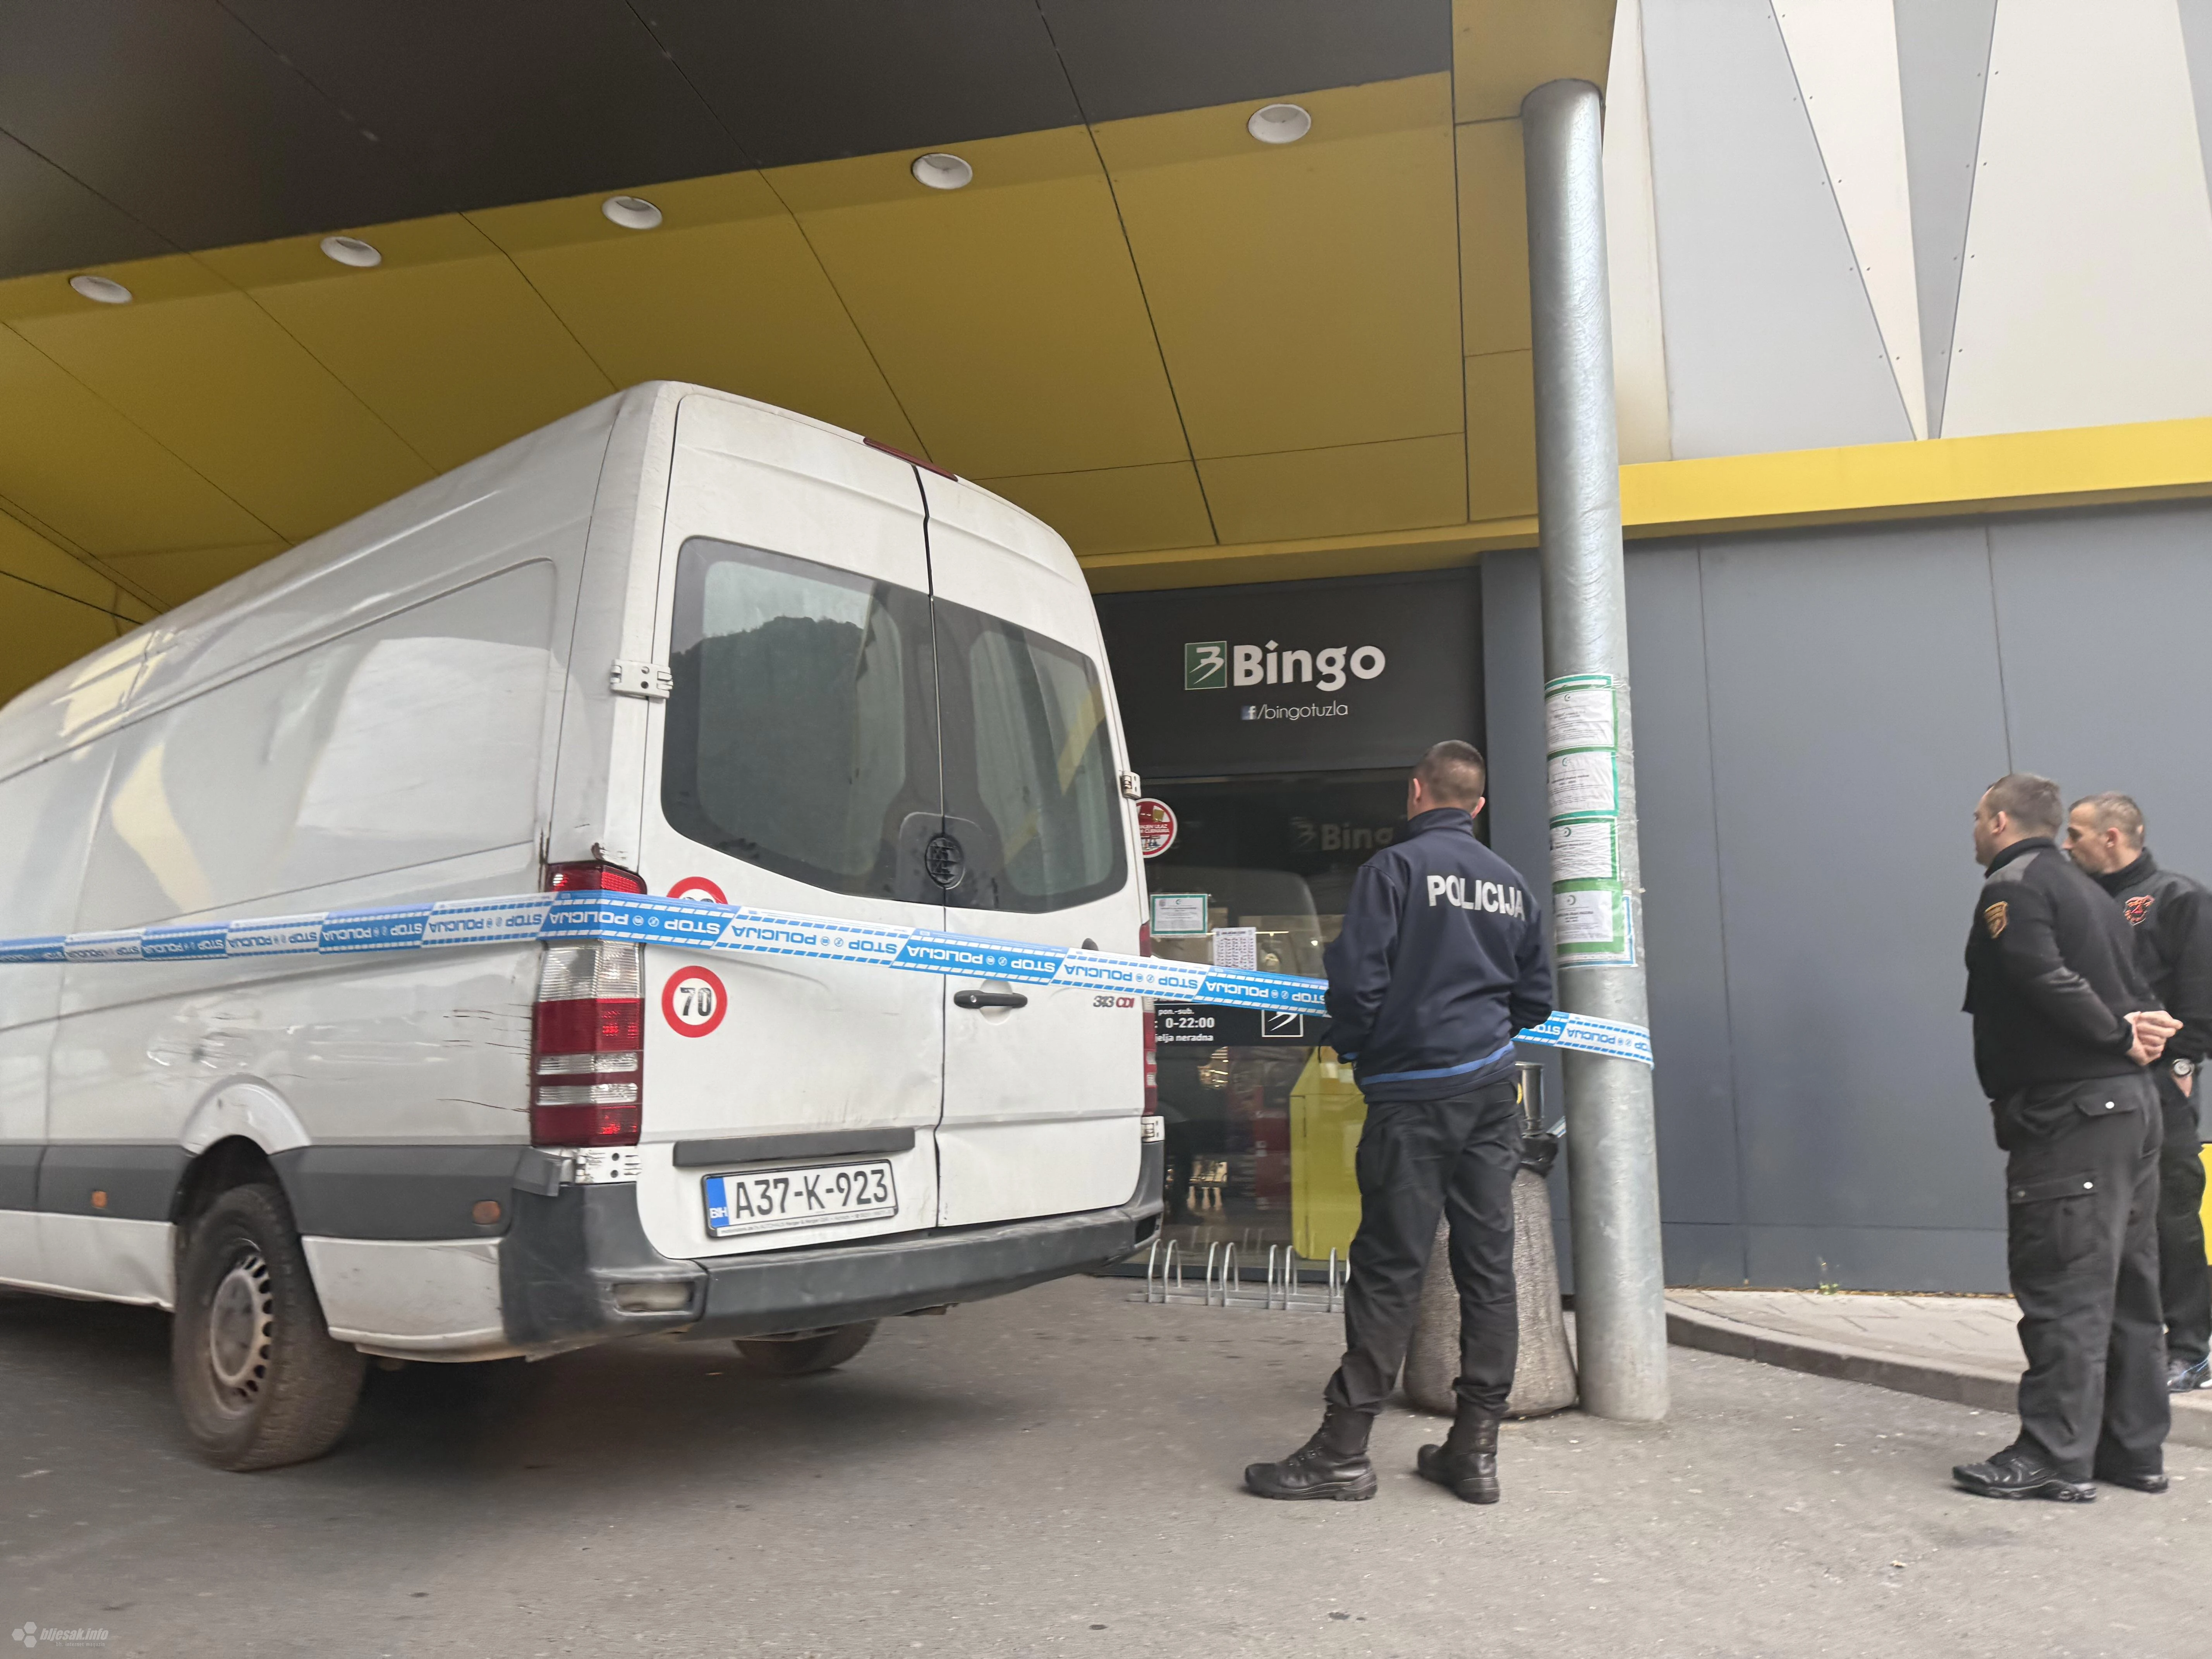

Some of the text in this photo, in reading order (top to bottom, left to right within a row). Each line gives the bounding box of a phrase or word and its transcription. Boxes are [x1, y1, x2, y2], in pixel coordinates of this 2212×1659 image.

[1234, 640, 1385, 691] Bingo
[1427, 875, 1525, 922] POLICIJA
[429, 918, 484, 933] POLICIJA
[505, 914, 542, 927] STOP
[549, 911, 629, 925] POLICIJA
[390, 923, 422, 936] STOP
[664, 920, 720, 935] STOP
[731, 925, 816, 945] POLICIJA
[289, 932, 318, 944] STOP
[848, 940, 898, 954] STOP
[907, 945, 983, 964] POLICIJA
[1011, 959, 1055, 973] STOP
[1064, 964, 1132, 981] POLICIJA
[1158, 977, 1198, 989] STOP
[1206, 981, 1268, 998] POLICIJA
[680, 987, 712, 1016] 70
[736, 1169, 888, 1219] A37-K-923
